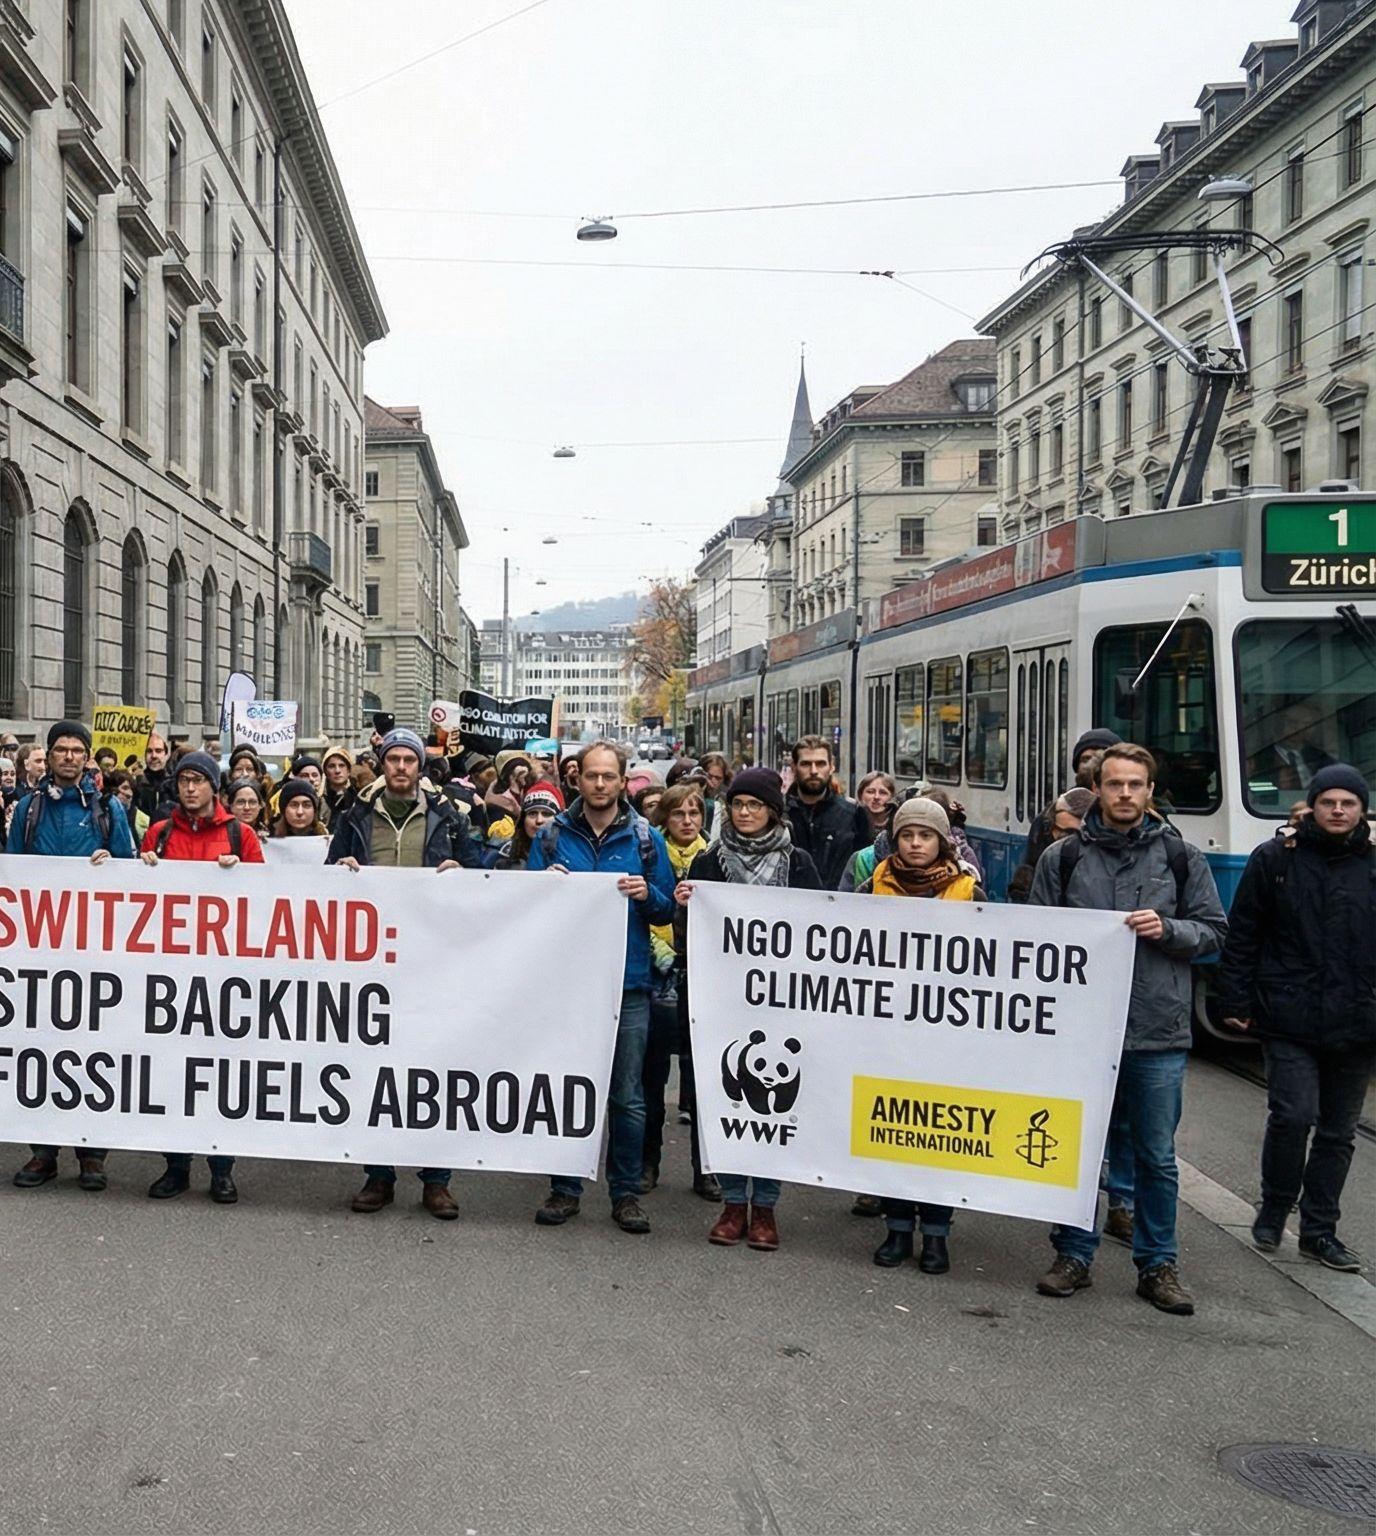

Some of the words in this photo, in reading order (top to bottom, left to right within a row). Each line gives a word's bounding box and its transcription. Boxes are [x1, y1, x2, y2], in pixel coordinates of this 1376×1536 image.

[1328, 508, 1348, 546] 1
[723, 916, 792, 959] NGO
[805, 923, 997, 977] COALITION
[1011, 940, 1088, 985] FOR
[144, 973, 391, 1046] BACKING
[745, 968, 894, 1019] CLIMATE
[904, 983, 1057, 1035] JUSTICE
[183, 1056, 352, 1126] FUELS
[367, 1066, 597, 1139] ABROAD
[870, 1095, 996, 1135] AMNESTY
[720, 1117, 798, 1146] WWF
[870, 1126, 994, 1158] INTERNATIONAL
